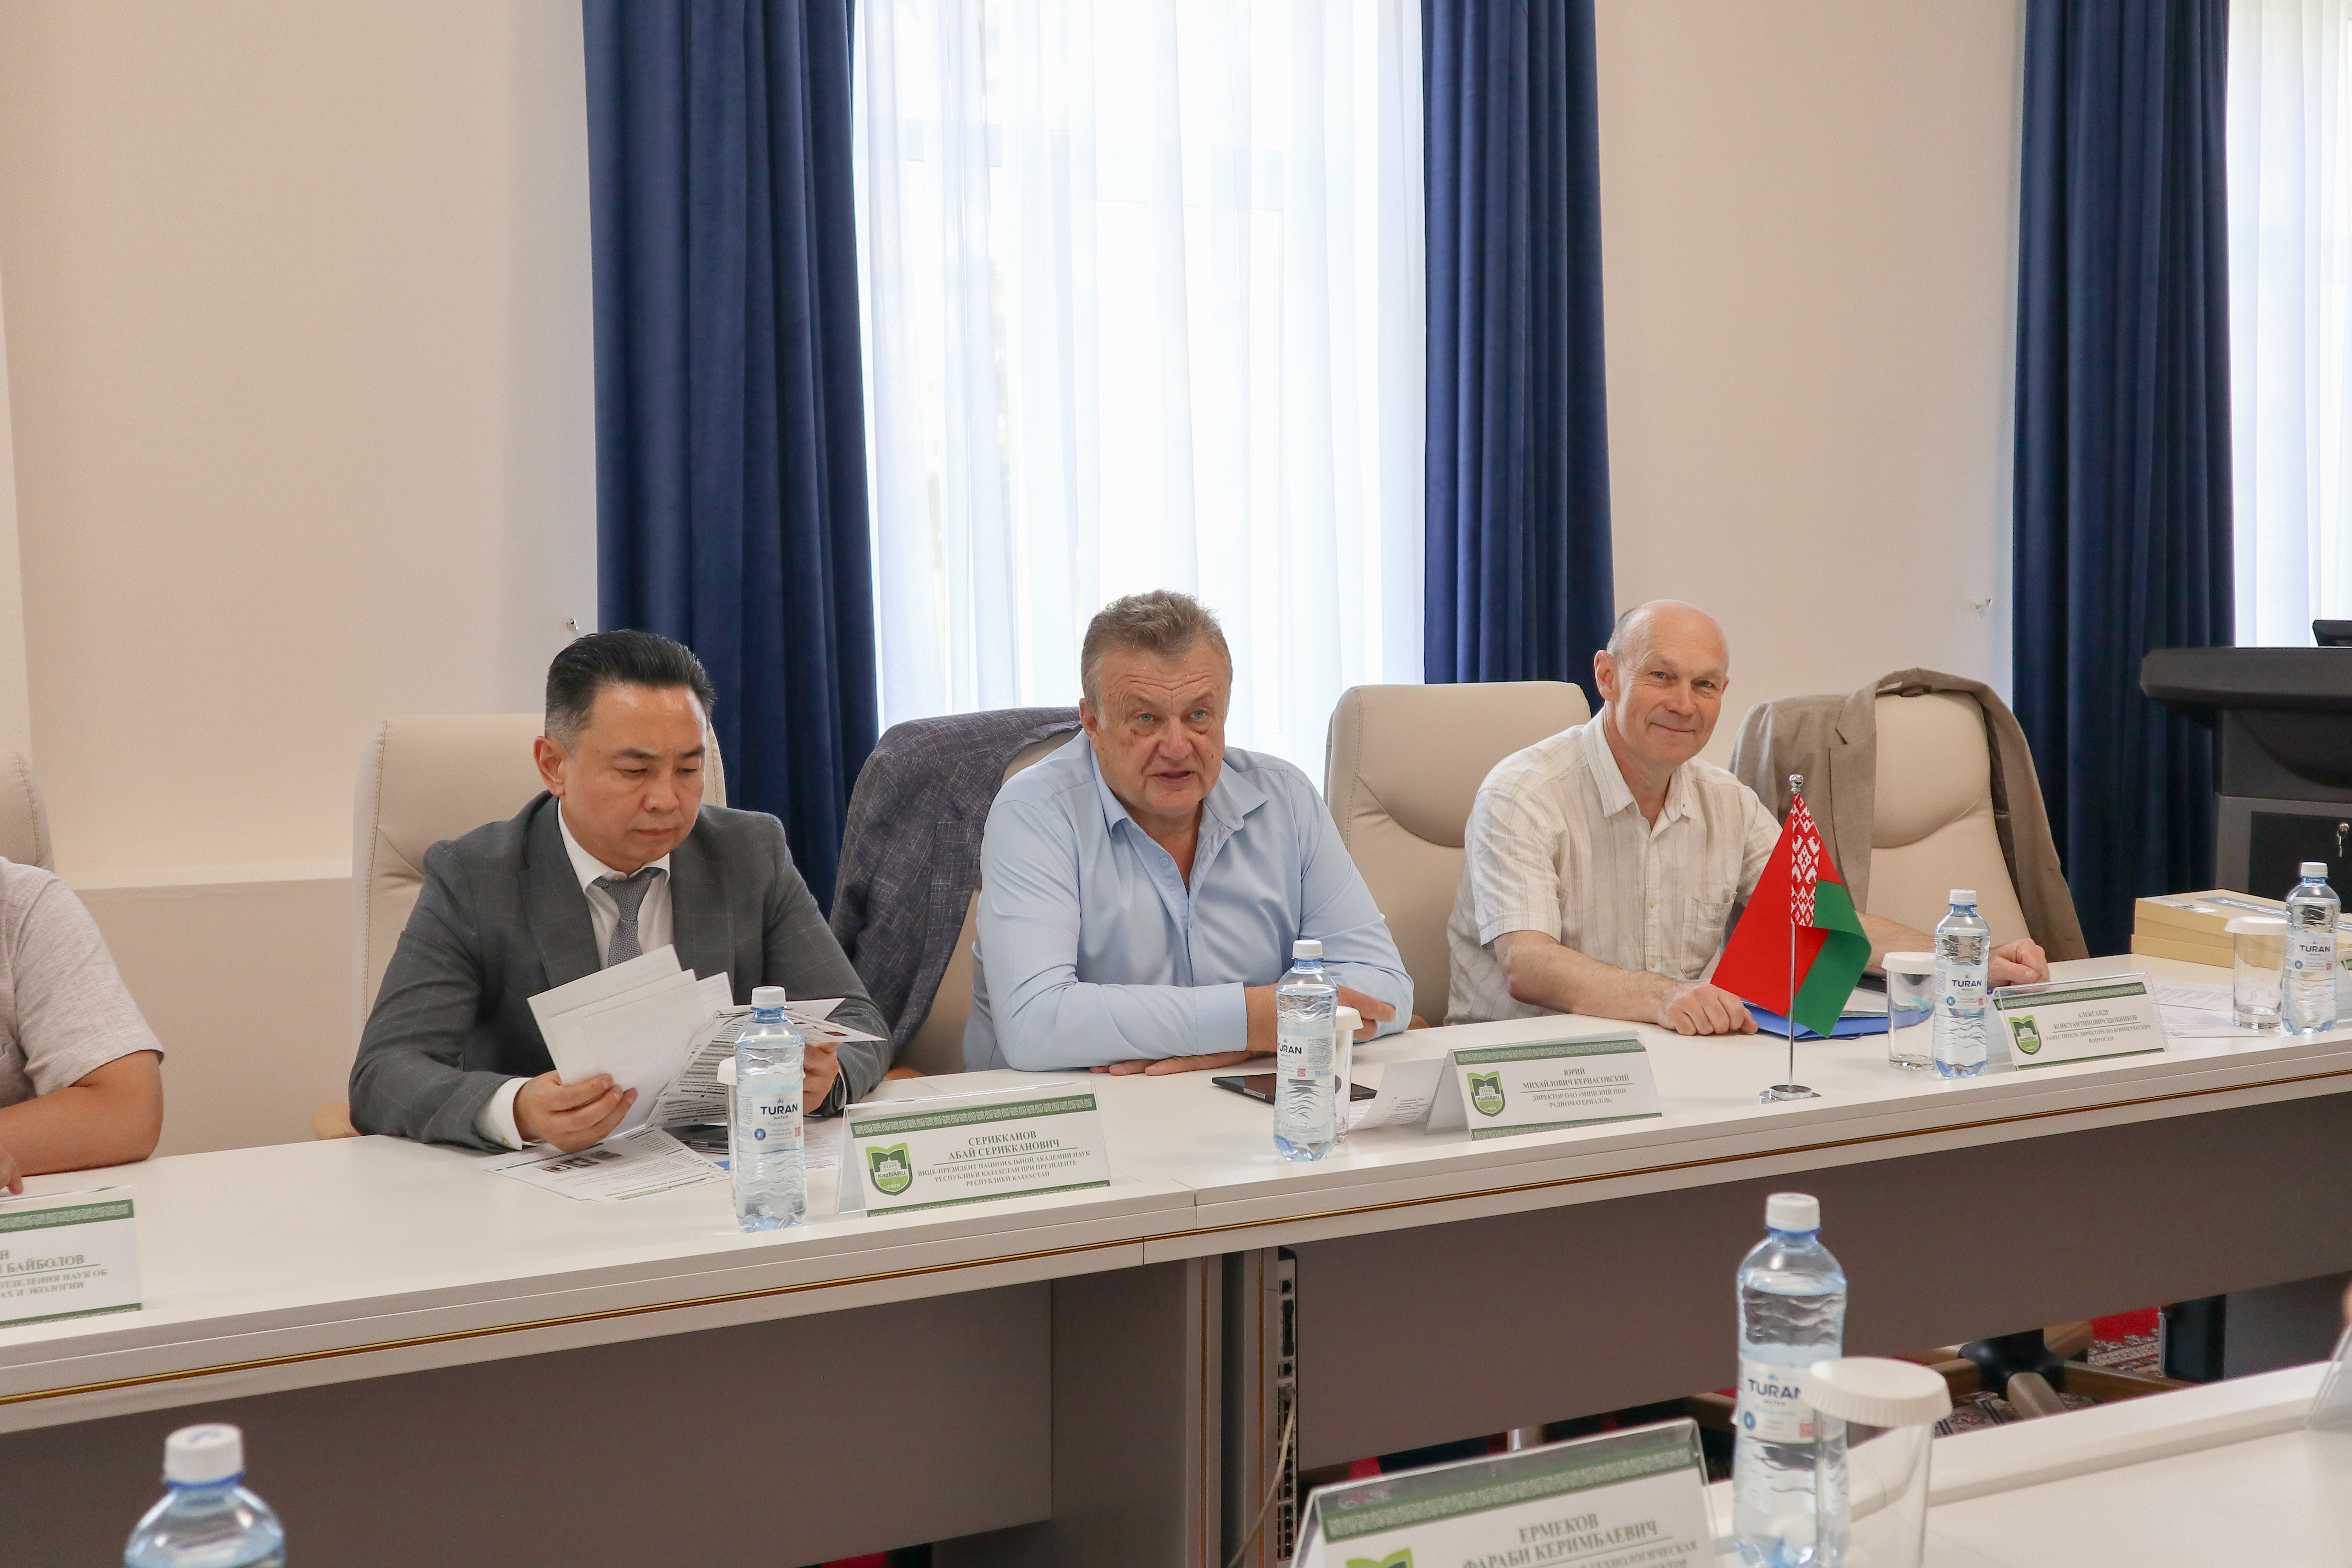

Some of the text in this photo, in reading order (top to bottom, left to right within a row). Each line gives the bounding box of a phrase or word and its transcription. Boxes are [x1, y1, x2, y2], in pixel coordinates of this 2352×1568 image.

[2078, 1009, 2109, 1018] АЛЕКСАНДР
[2054, 1015, 2138, 1029] КОНСТАНТИНОВИЧ ЗДОБНИКОВ
[2113, 1024, 2151, 1033] КОММЕРЧЕСКИМ
[1277, 1043, 1302, 1054] TURAN
[1564, 1067, 1585, 1076] ЮРИЙ
[1523, 1073, 1630, 1089] МИХАЙЛОВИЧ КЕРНАСОВСКИЙ
[1578, 1088, 1612, 1097] «МИНСКИЙ
[760, 1103, 798, 1115] TURAN
[1550, 1098, 1613, 1108] РАДИОМАТЕРИАЛОВ»
[968, 1131, 1036, 1146] СЕРИККАНОВ
[949, 1139, 1060, 1160] АБАЙ СЕРИККАНОВИЧ
[918, 1164, 977, 1176] ВИЦЕ-ПРЕЗИДЕНТ
[979, 1157, 1034, 1169] НАЦИОНАЛЬНОЙ
[1036, 1152, 1072, 1162] АКАДЕМИИ
[935, 1172, 980, 1182] РЕСПУБЛИКИ
[981, 1167, 1020, 1177] КАЗАХСТАН
[1036, 1160, 1077, 1170] ПРЕЗИДЕНТЕ
[966, 1171, 1050, 1187] РЕСПУБЛИКИ КАЗАХСТАН
[7, 1254, 85, 1273] БАЙБОЛОВ
[63, 1271, 91, 1281] НАУК
[93, 1269, 107, 1277] ОБ
[29, 1281, 85, 1295] ЭКОЛОГИИ
[1518, 1514, 1599, 1544] ЕРМЕКОВ
[1463, 1520, 1658, 1568] ФАРАБИ КЕРИМБАЕВИЧ
